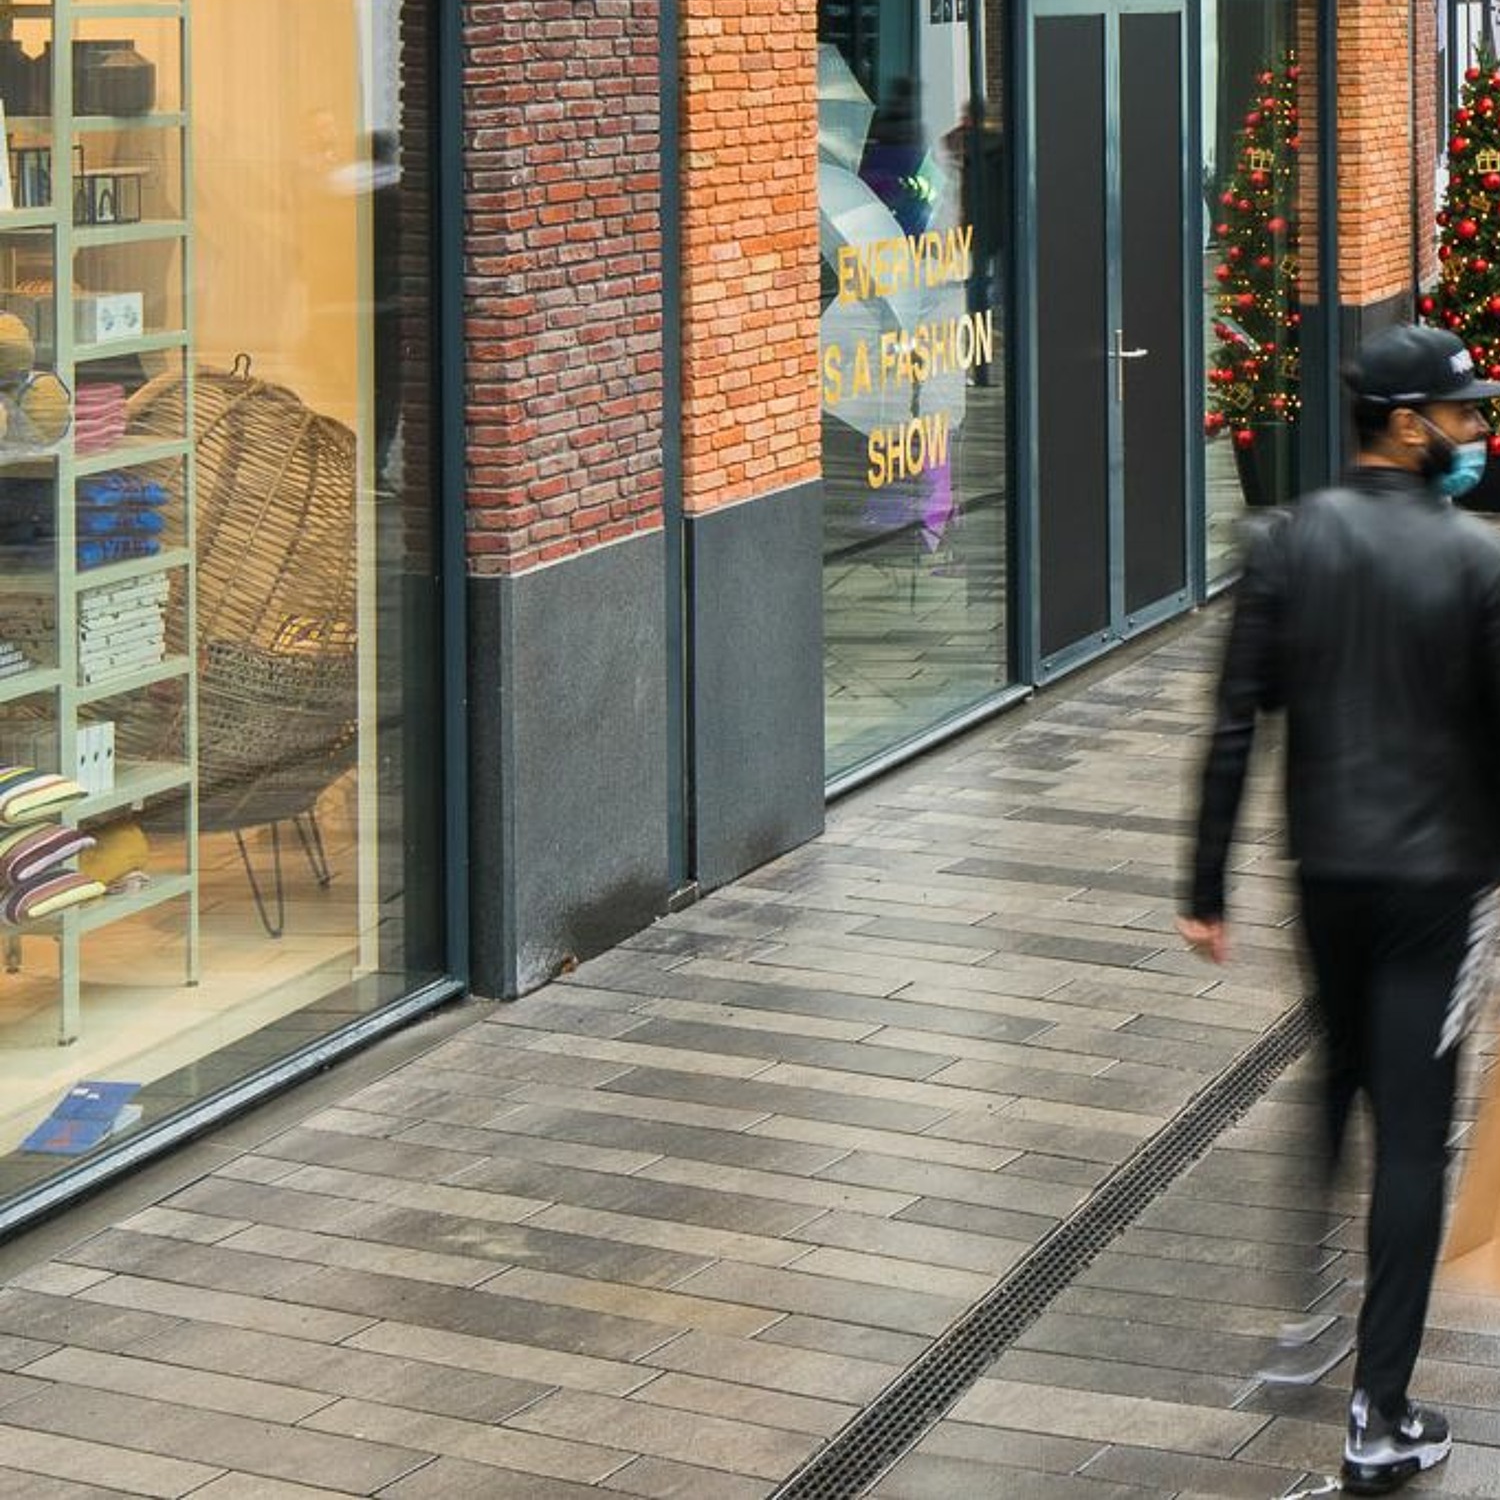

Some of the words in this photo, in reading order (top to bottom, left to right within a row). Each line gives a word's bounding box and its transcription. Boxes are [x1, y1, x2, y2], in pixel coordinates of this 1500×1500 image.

[837, 224, 974, 305] EVERYDAY
[823, 343, 843, 406] S
[853, 337, 873, 396] A
[879, 308, 994, 387] FASHION
[867, 410, 950, 489] SHOW
